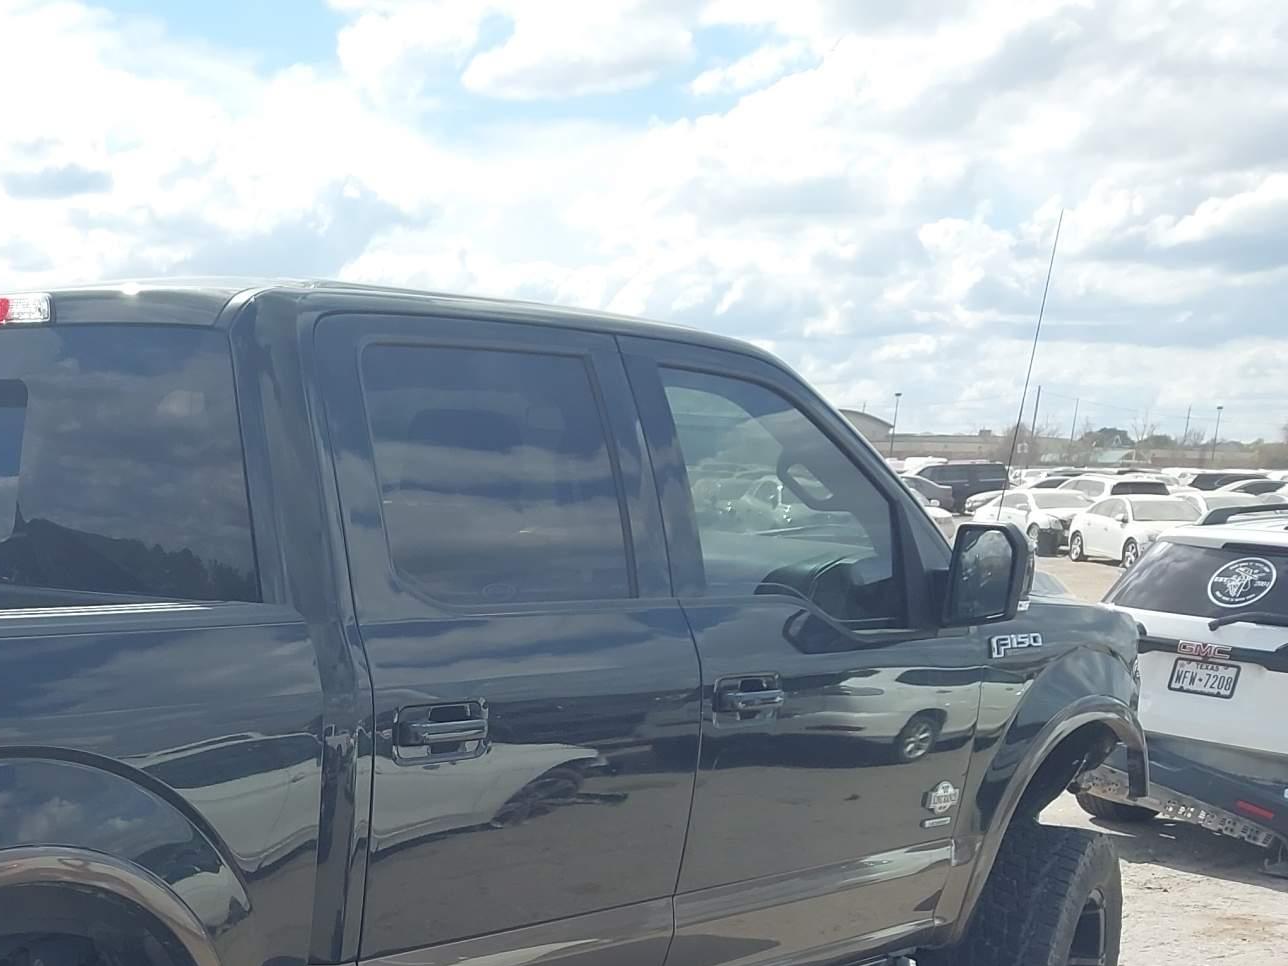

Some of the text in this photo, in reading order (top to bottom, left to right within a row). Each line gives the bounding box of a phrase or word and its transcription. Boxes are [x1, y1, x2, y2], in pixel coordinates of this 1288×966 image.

[991, 633, 1043, 658] F150
[1177, 640, 1232, 659] GMC
[1196, 663, 1220, 672] TEXAS
